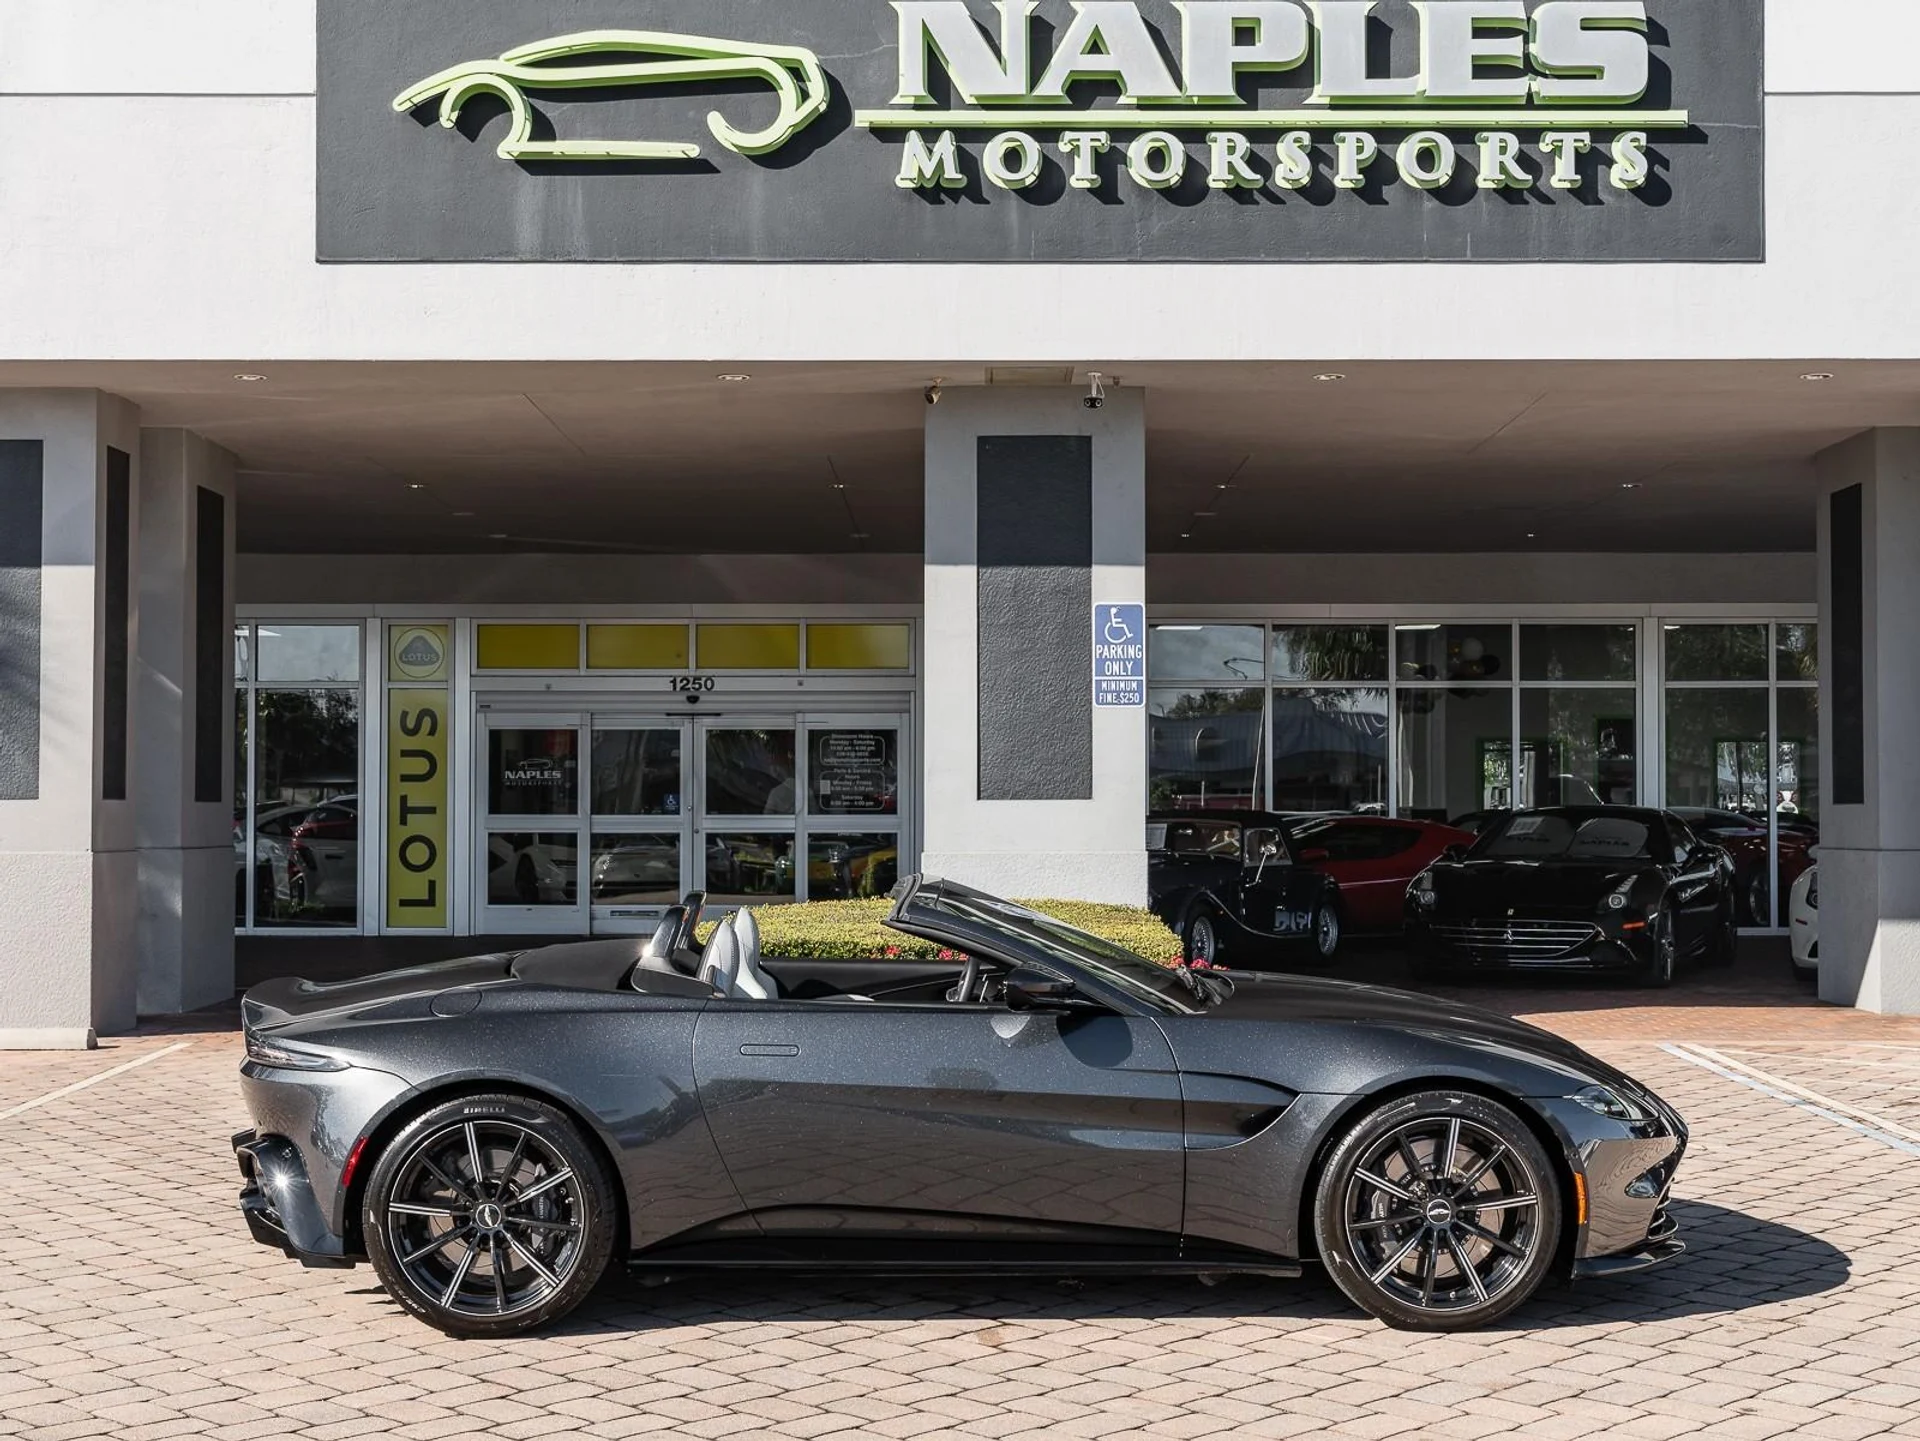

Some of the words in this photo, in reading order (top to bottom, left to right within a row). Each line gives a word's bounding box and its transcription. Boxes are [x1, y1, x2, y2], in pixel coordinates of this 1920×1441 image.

[889, 0, 1651, 105] NAPLES
[895, 130, 1650, 190] MOTORSPORTS
[402, 653, 437, 661] LOTUS
[1096, 644, 1142, 659] PARKING
[1105, 661, 1133, 675] ONLY
[669, 677, 715, 691] 1250
[1101, 681, 1138, 691] MINIMUM
[1099, 693, 1118, 703] FINE
[1120, 693, 1140, 703] $250
[505, 770, 562, 779] NAPLES
[399, 708, 438, 907] LOTUS
